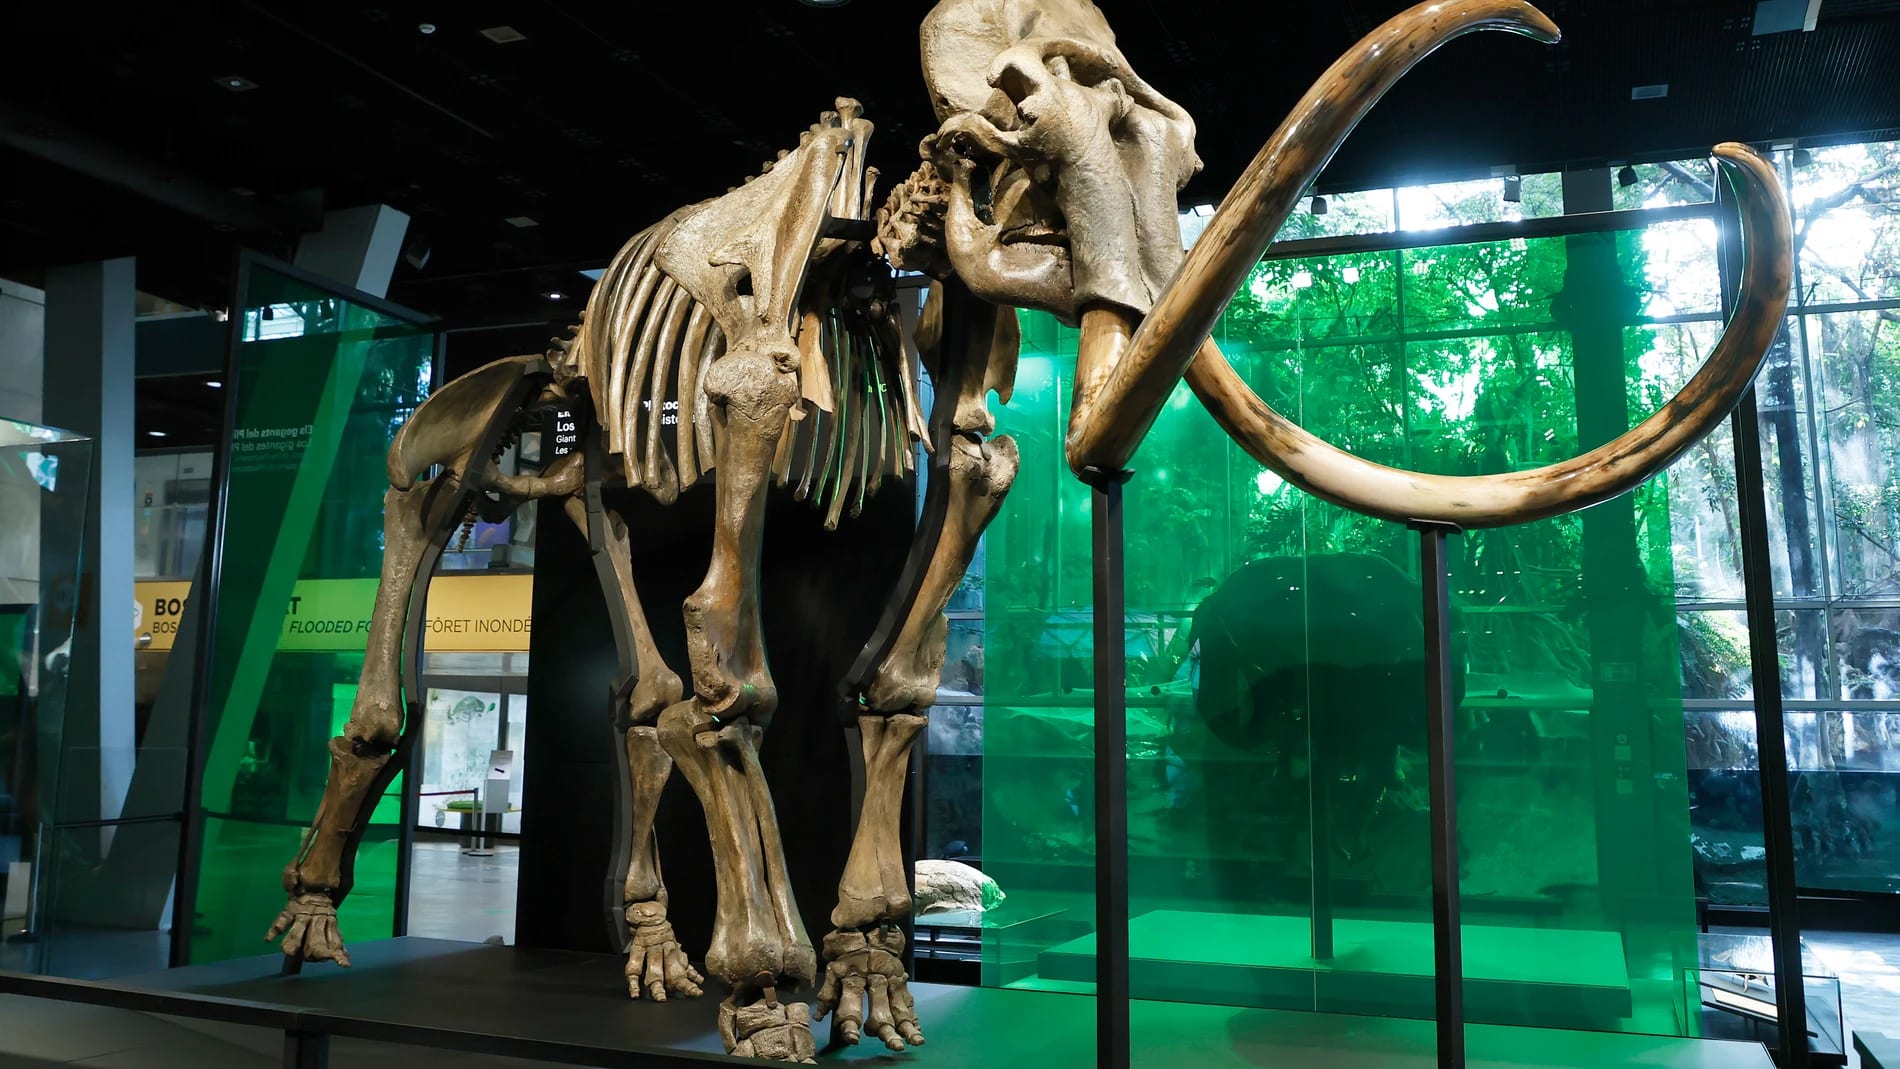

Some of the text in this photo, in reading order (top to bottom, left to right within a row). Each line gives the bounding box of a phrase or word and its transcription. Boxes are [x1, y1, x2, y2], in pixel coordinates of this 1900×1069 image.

[557, 421, 575, 432] Los
[555, 434, 577, 444] Giant
[555, 446, 569, 455] Les
[152, 621, 178, 634] BOS
[289, 620, 353, 634] FLOODED
[475, 616, 533, 633] INONDÉ
